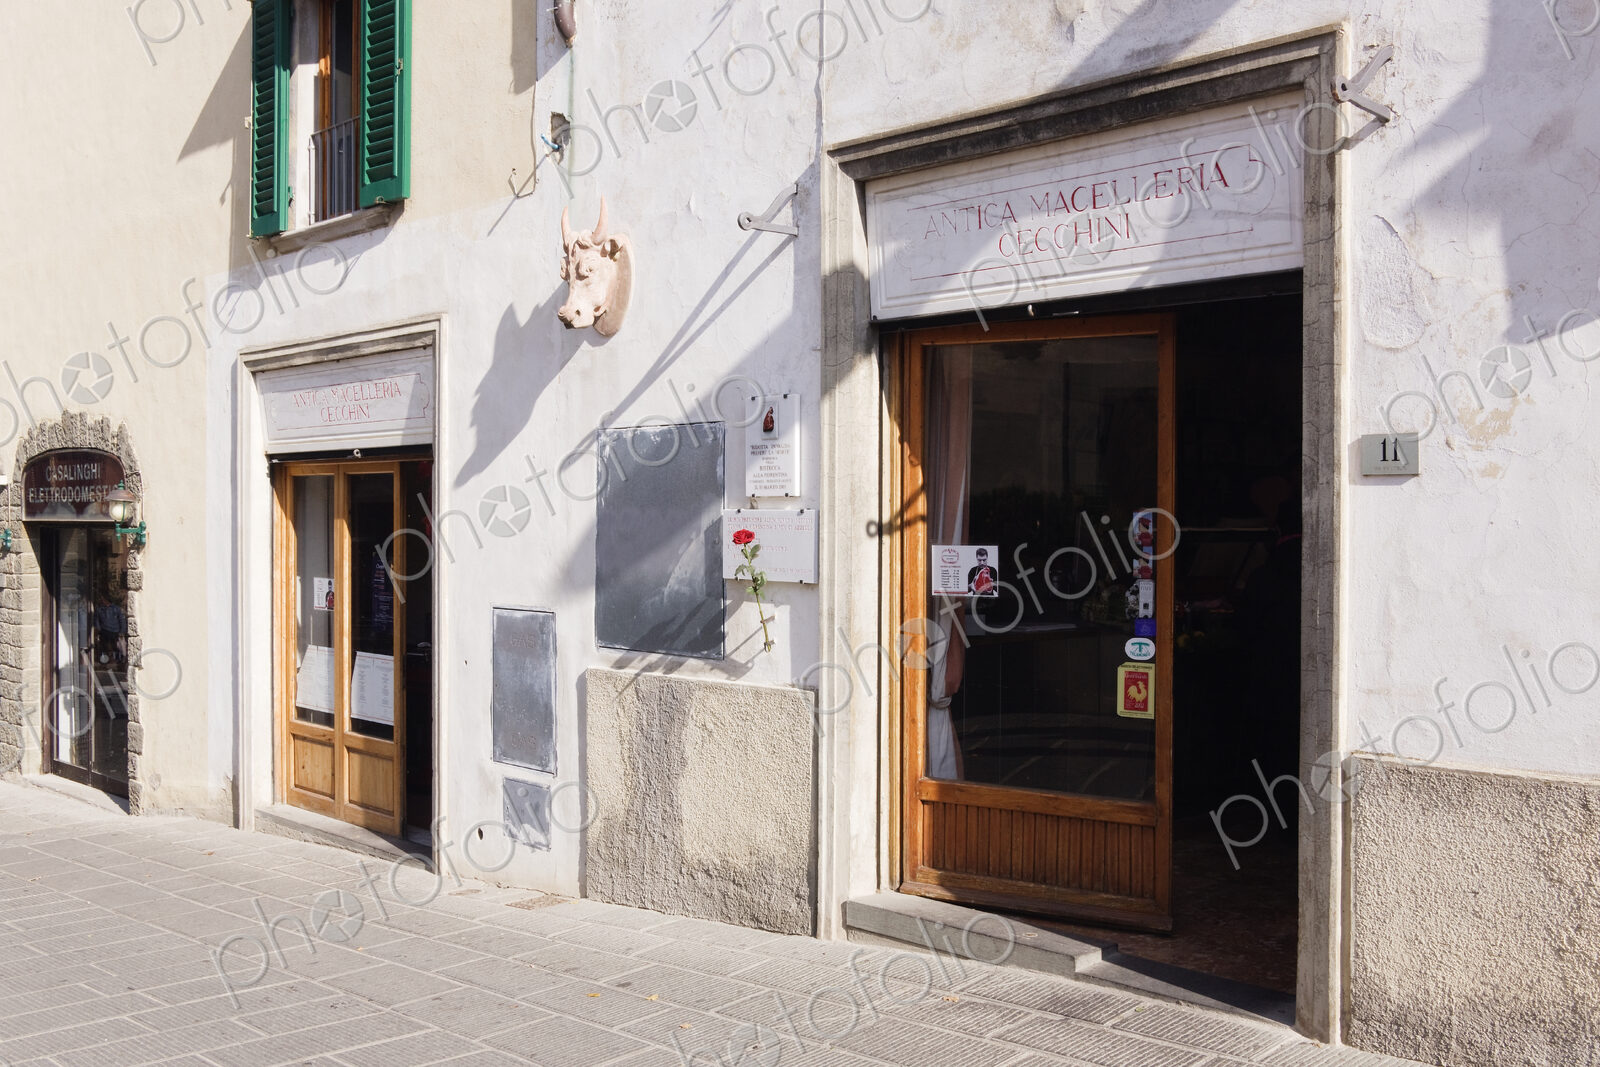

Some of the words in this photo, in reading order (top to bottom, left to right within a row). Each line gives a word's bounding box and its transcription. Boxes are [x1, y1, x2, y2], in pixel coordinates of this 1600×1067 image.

[923, 200, 1018, 240] ANTICA
[1029, 160, 1231, 221] MACELLERIA
[998, 212, 1132, 258] CECCHINI
[292, 390, 328, 408] ANTICA
[330, 380, 402, 404] MACELLERIA
[320, 402, 370, 423] CECCHINI
[1380, 437, 1400, 462] 11
[45, 463, 101, 481] CASALINGHI
